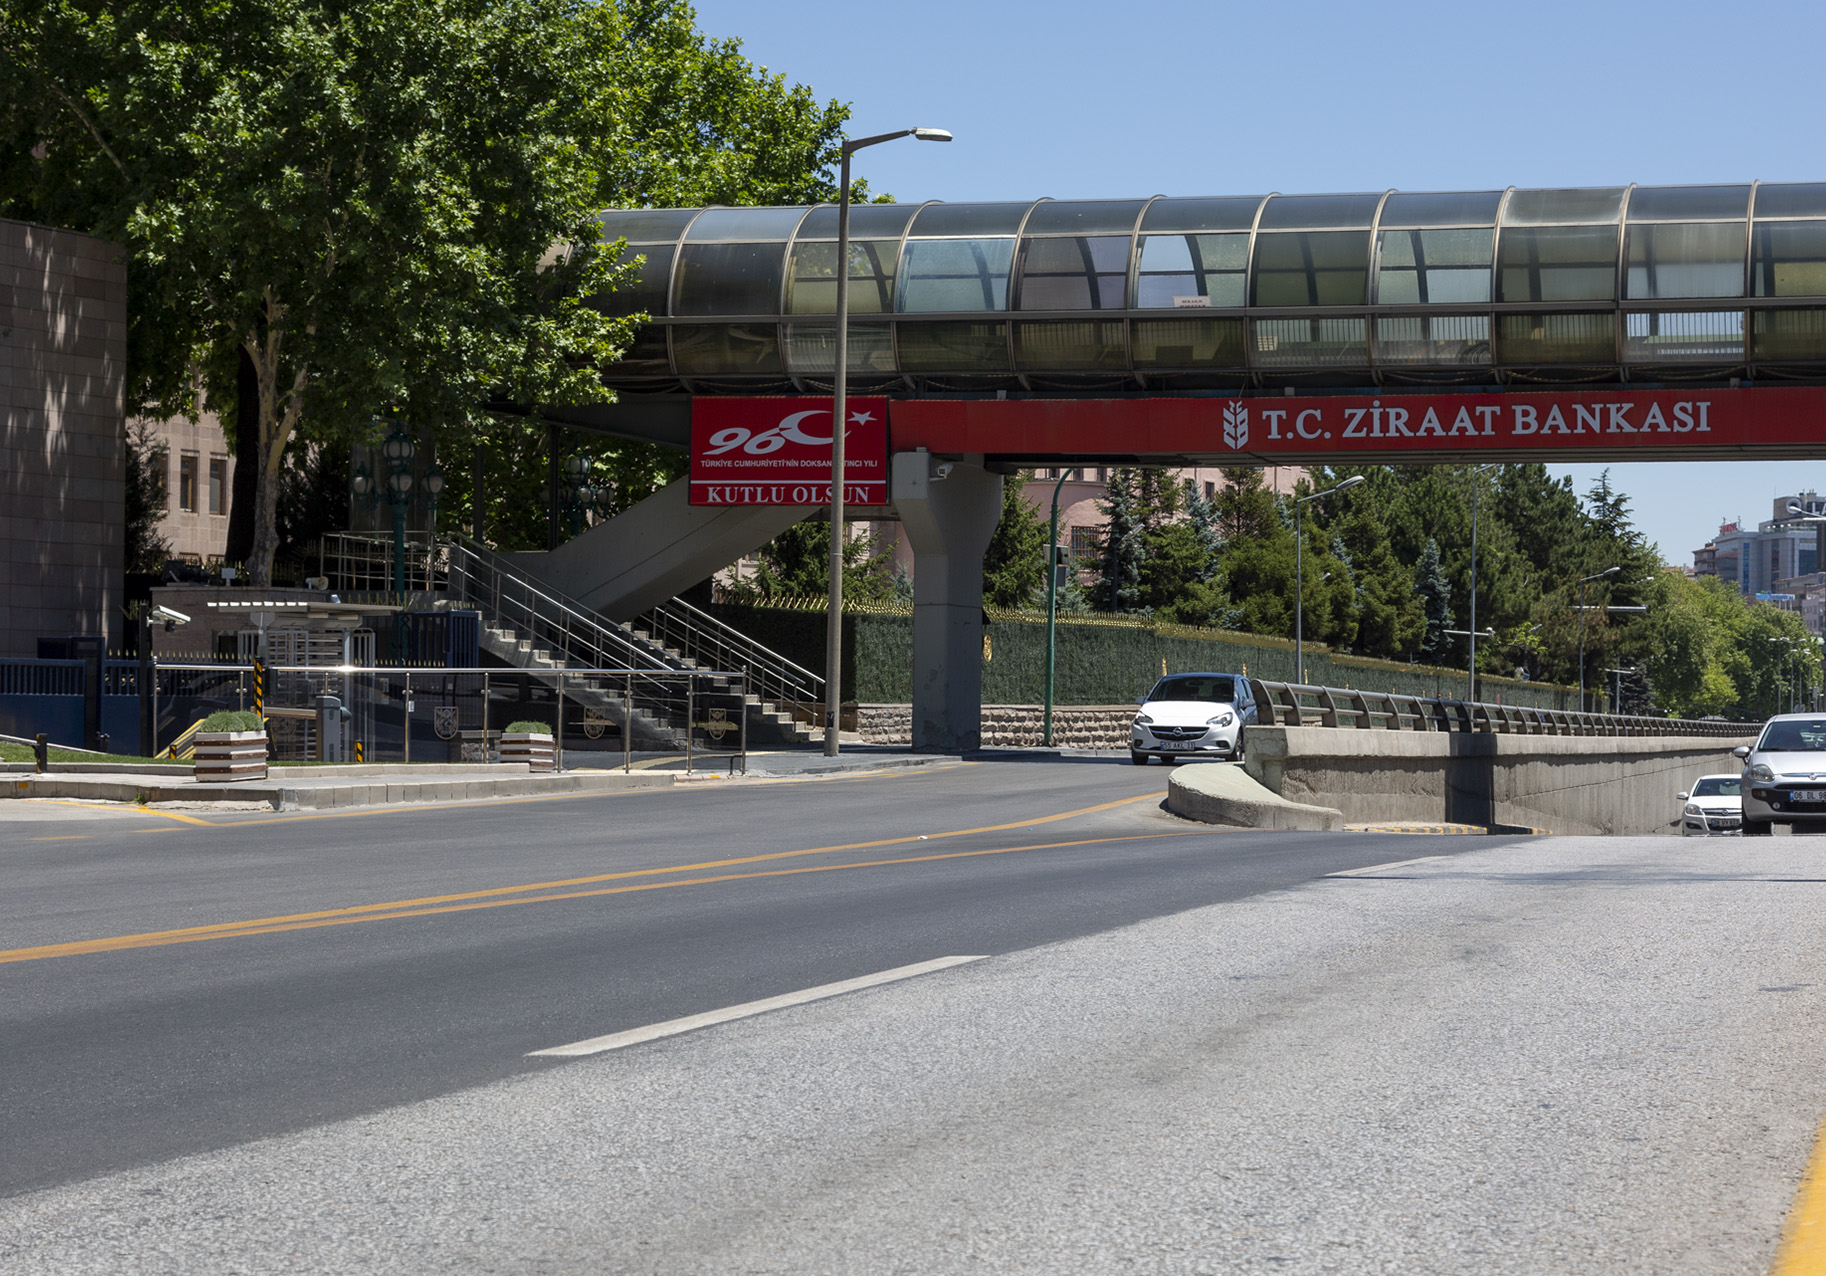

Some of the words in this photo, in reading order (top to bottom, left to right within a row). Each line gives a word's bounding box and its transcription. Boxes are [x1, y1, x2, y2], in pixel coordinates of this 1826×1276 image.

[1261, 409, 1332, 440] T.C.
[1342, 399, 1501, 438] ZİRAAT
[1511, 401, 1712, 435] BANKASI
[702, 427, 786, 455] 96
[700, 459, 732, 467] TÜRKİYE
[734, 459, 799, 467] CUMHURİYETİ'NİN
[800, 460, 832, 468] DOKSAN
[863, 460, 878, 468] YILI
[707, 486, 785, 503] KUTLU
